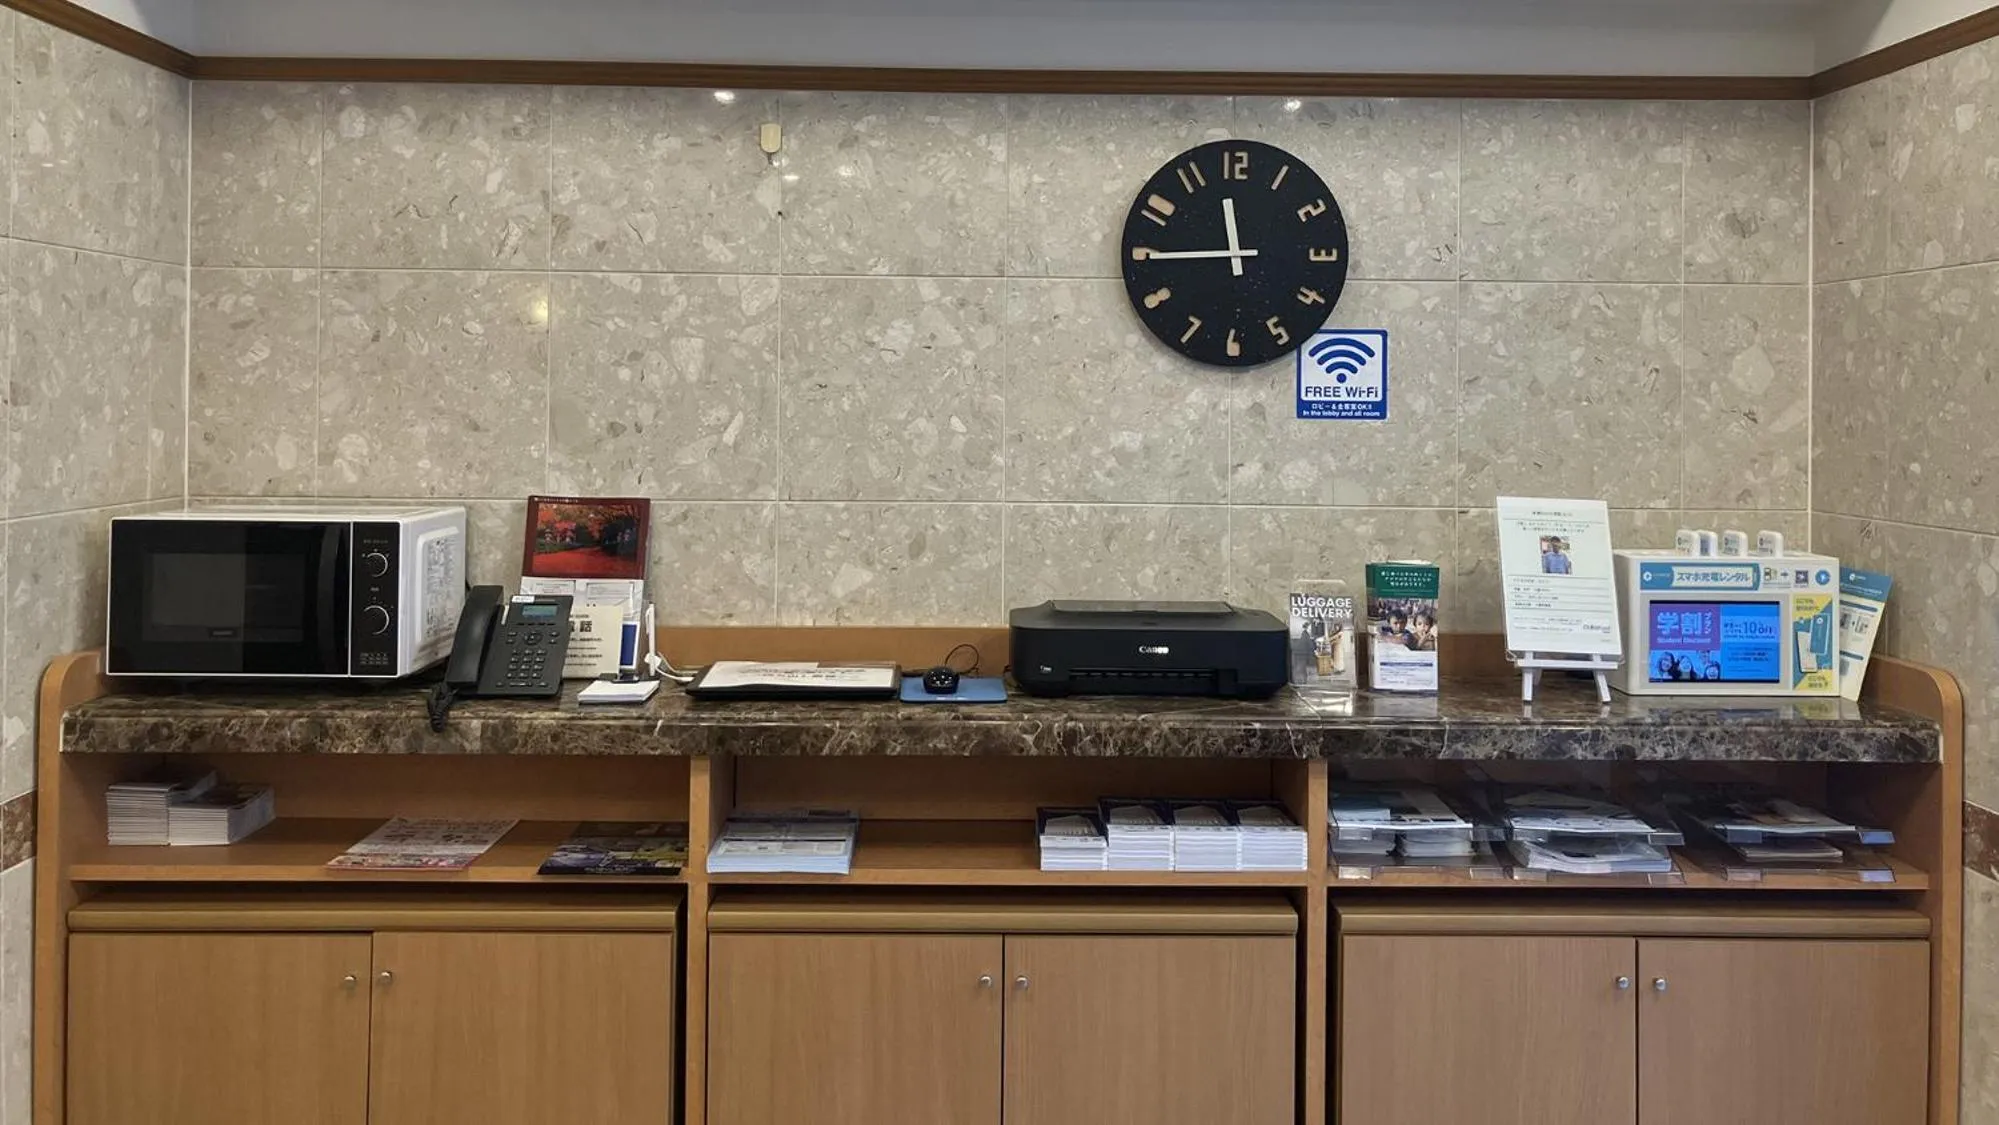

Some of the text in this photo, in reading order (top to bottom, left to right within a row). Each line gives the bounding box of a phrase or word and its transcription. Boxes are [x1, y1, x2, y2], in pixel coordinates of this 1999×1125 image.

[1223, 151, 1249, 180] 12
[1176, 161, 1207, 194] 11
[1270, 165, 1289, 191] 1
[1140, 193, 1176, 227] 10
[1297, 198, 1327, 222] 2
[1309, 247, 1338, 262] 3
[1144, 287, 1171, 309] 8
[1297, 286, 1325, 305] 4
[1179, 315, 1202, 344] 7
[1265, 315, 1290, 346] 5
[1226, 328, 1241, 357] 6
[1305, 386, 1378, 398] FREE Wi-Fi
[1322, 410, 1340, 418] lobby
[1291, 596, 1352, 608] LUGGAGE
[1291, 607, 1352, 619] DELIVERY
[1139, 645, 1170, 654] Can
